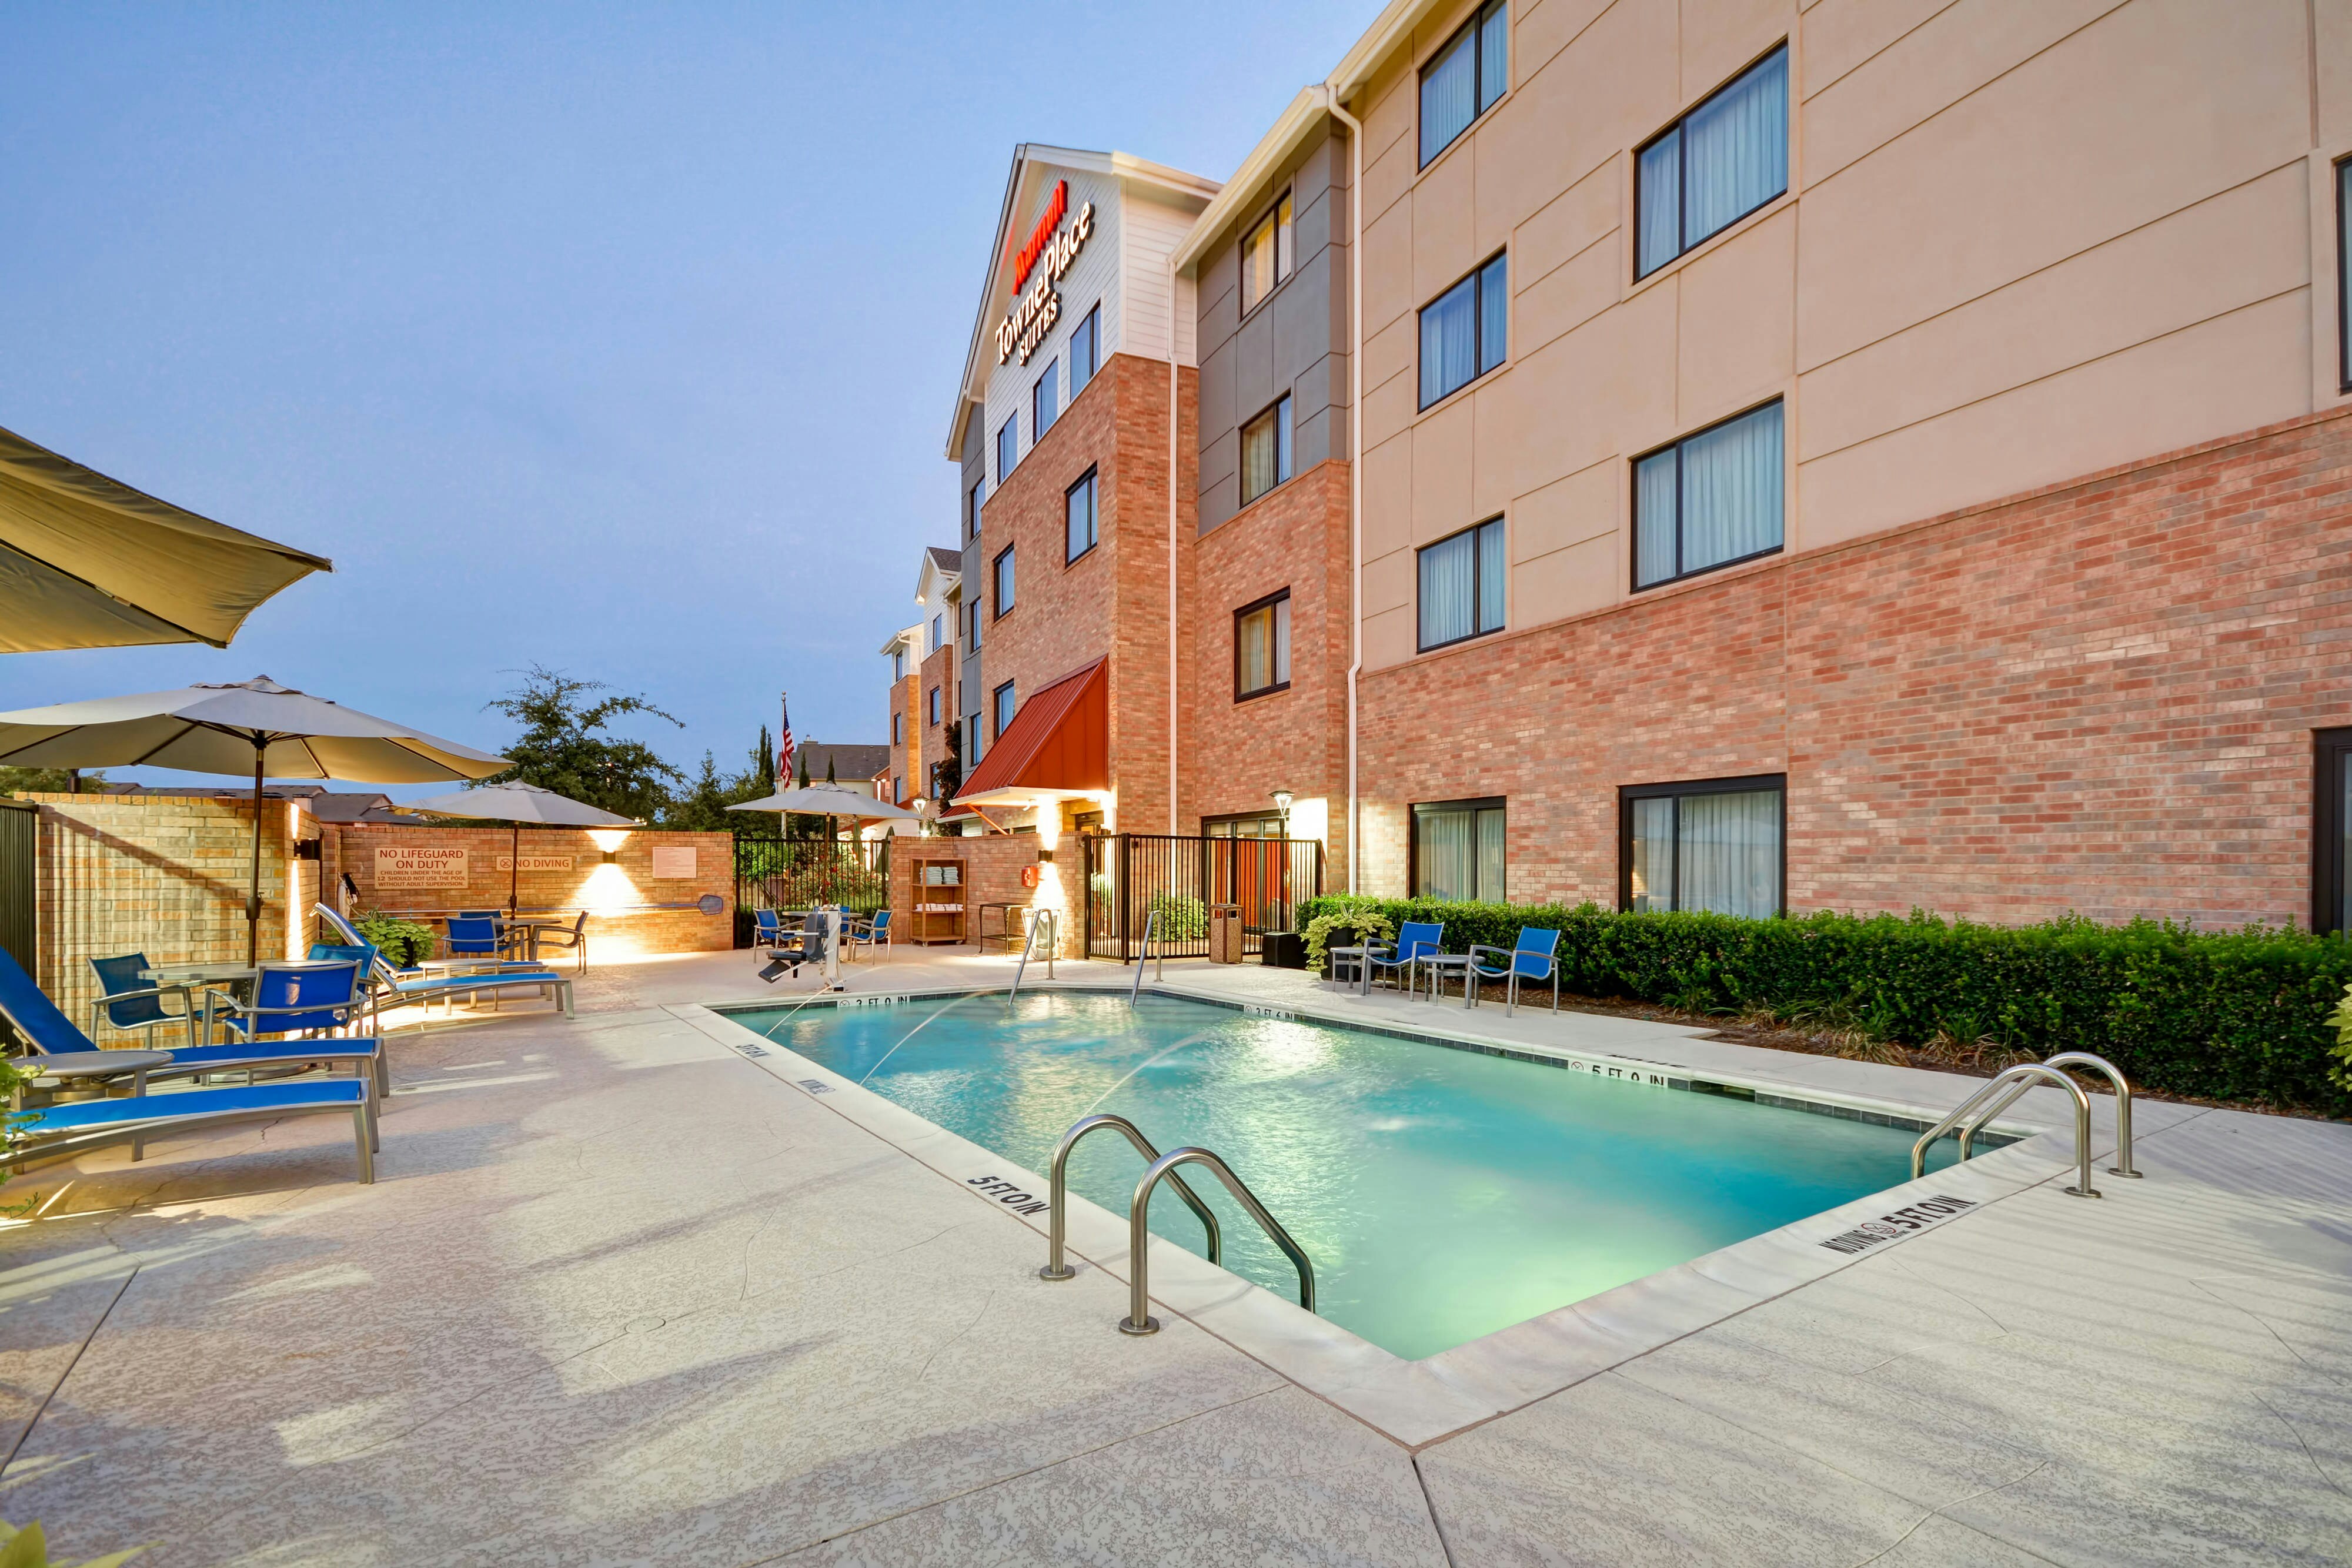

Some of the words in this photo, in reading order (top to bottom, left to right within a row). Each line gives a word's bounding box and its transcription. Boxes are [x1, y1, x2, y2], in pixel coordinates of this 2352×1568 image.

[1013, 179, 1066, 295] Marriott
[995, 200, 1093, 365] TownePlace
[1018, 292, 1059, 366] SUITES
[380, 850, 397, 858] NO
[402, 850, 463, 858] LIFEGUARD
[396, 860, 413, 869] ON
[417, 860, 449, 869] DUTY
[516, 859, 530, 868] NO
[534, 859, 569, 868] DIVING
[1264, 1009, 1272, 1017] FT
[1285, 1012, 1292, 1020] IN
[1592, 1065, 1601, 1074] 5
[1609, 1067, 1623, 1078] FT
[1650, 1074, 1663, 1086] IN
[967, 1176, 1001, 1185] 5
[1818, 1241, 1859, 1255] NO
[1880, 1216, 1922, 1229] 5
